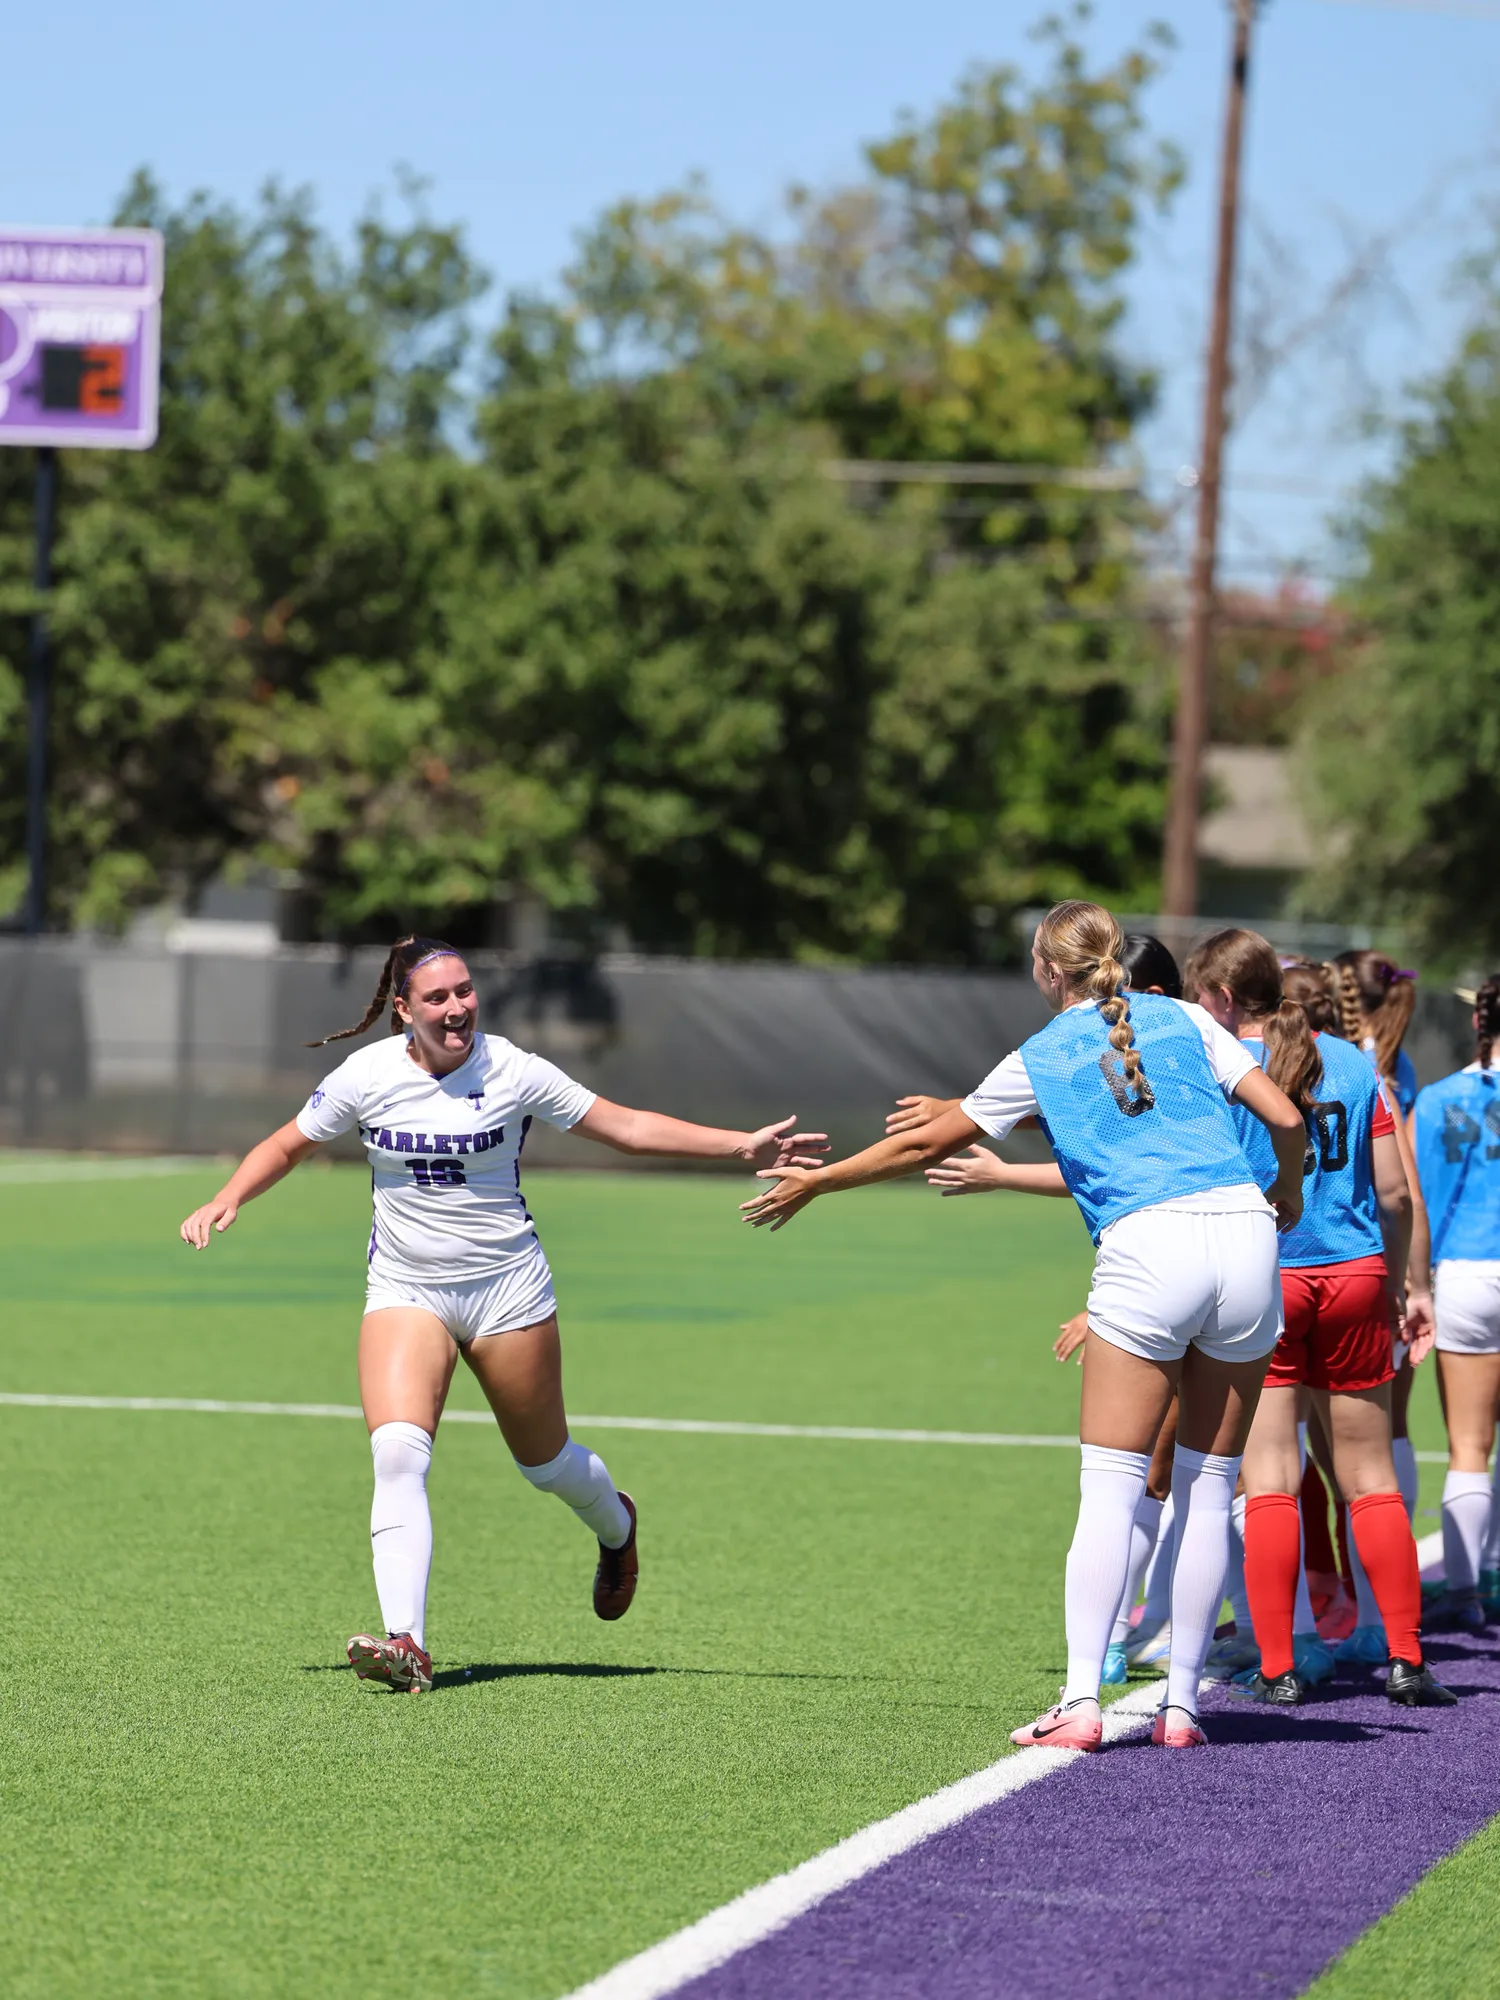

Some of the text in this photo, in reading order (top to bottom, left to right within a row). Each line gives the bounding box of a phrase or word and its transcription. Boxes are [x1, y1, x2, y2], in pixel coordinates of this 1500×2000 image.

[81, 343, 126, 416] 2
[367, 1126, 505, 1155] TARLETON
[405, 1159, 467, 1187] 16
